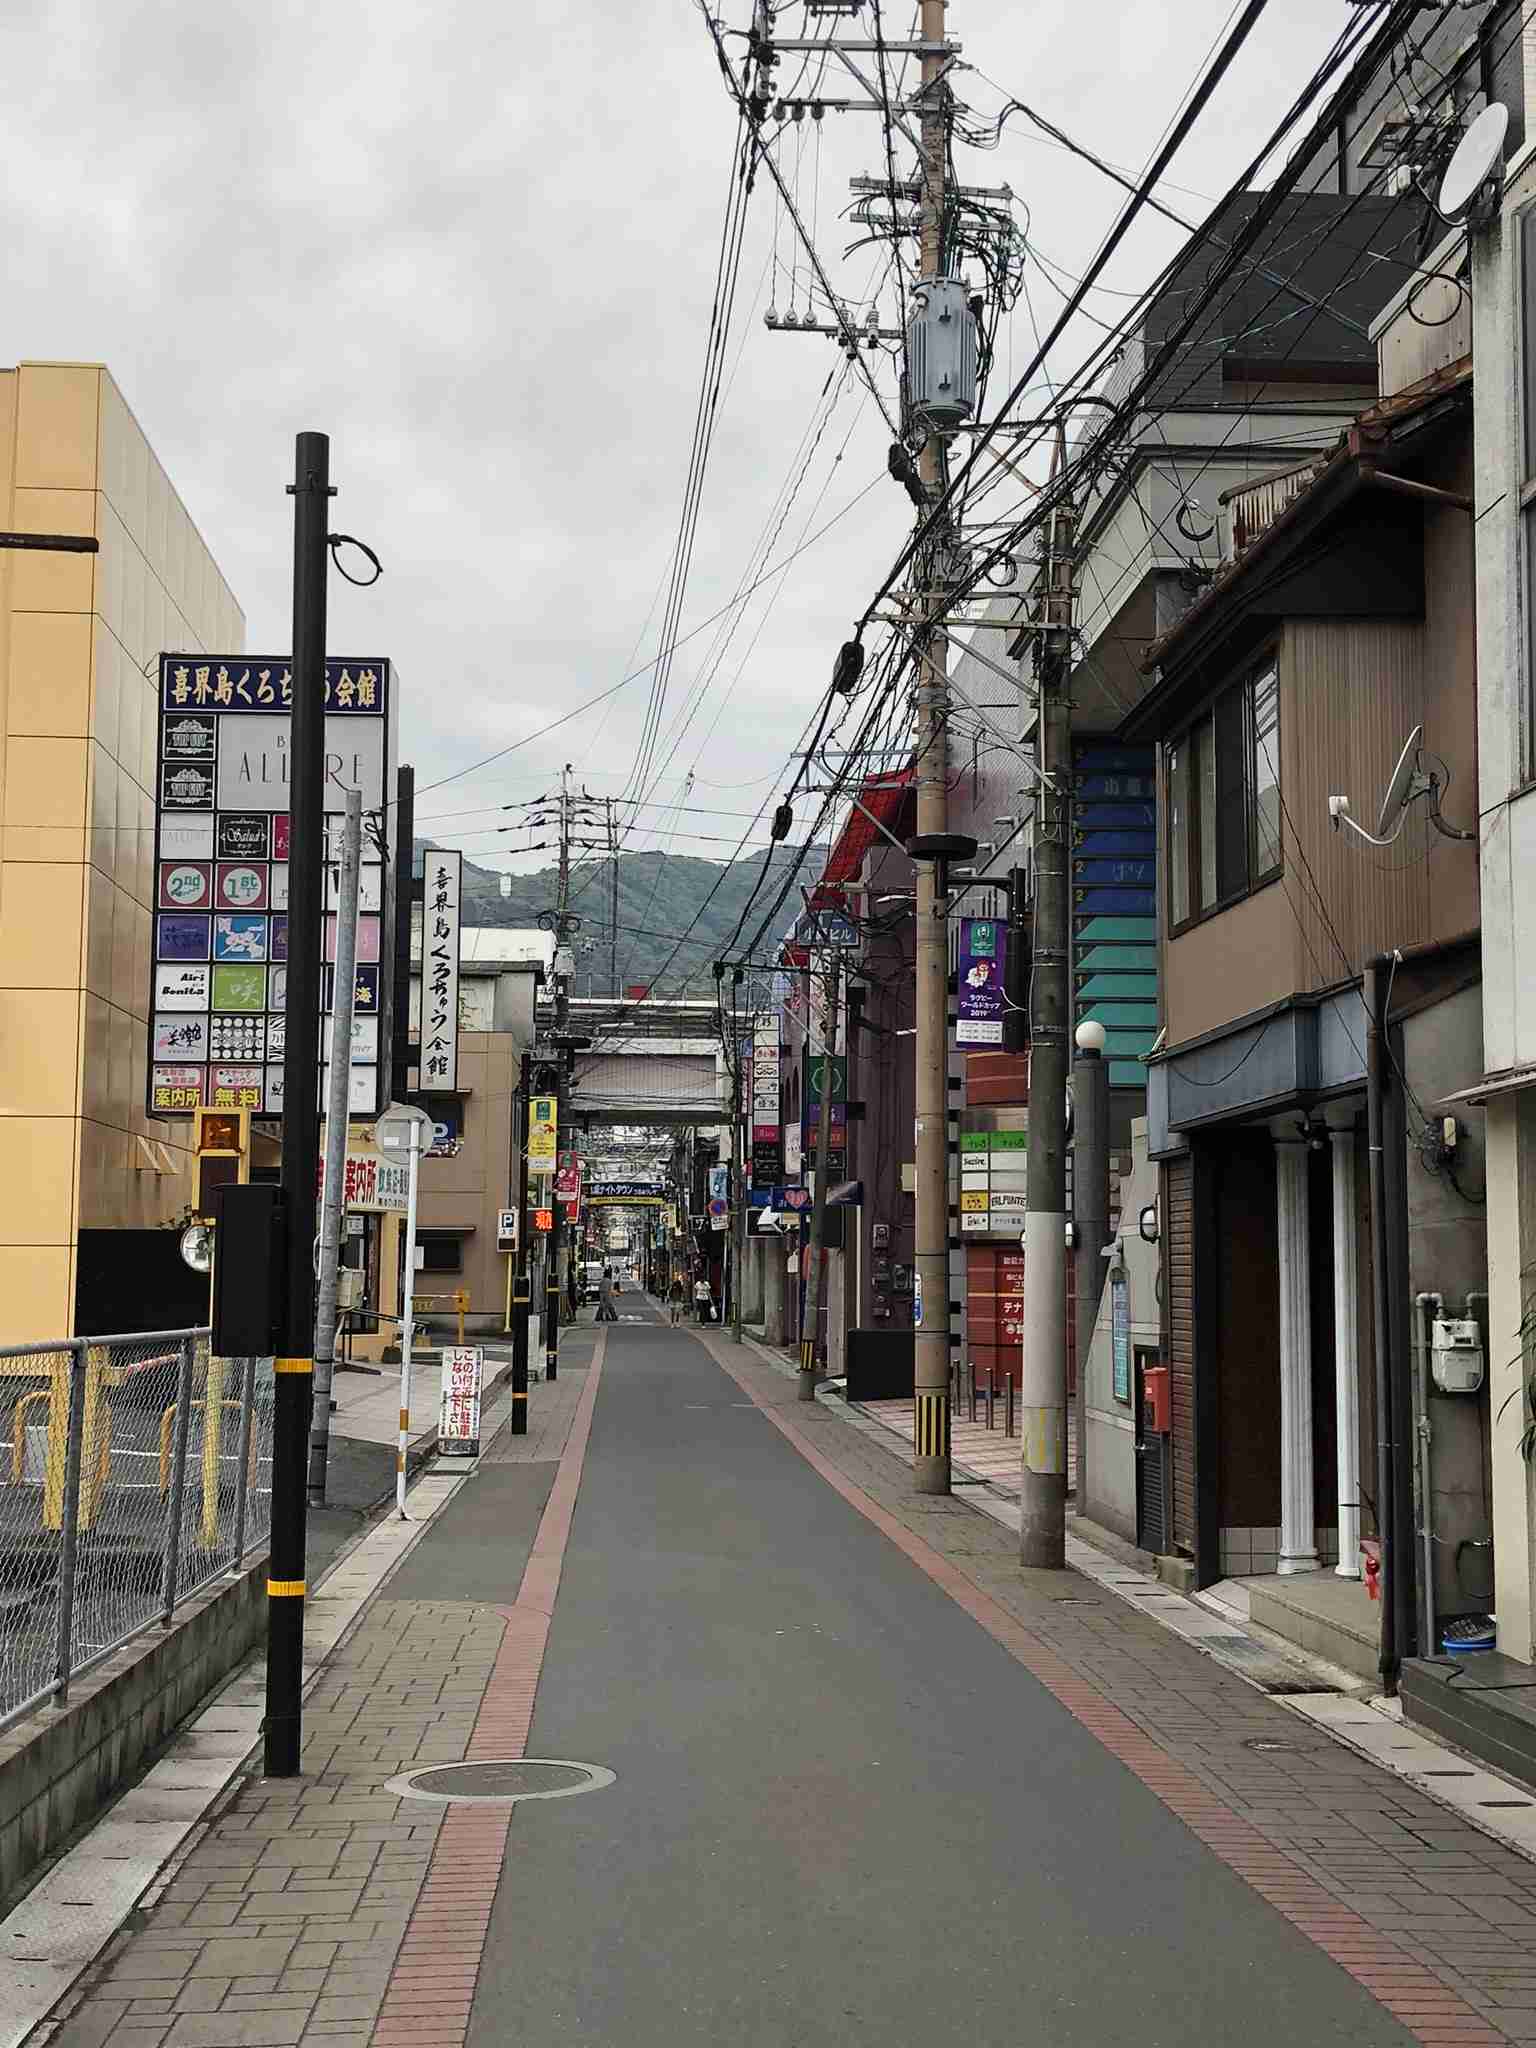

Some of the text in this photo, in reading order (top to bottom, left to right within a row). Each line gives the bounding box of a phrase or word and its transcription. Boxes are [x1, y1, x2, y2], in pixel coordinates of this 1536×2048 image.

[171, 665, 377, 707] 喜界島くろち会館
[239, 752, 366, 784] ALLRE
[171, 874, 200, 897] 2nd
[228, 875, 257, 898] 1st
[181, 973, 205, 982] Airi
[427, 867, 456, 1075] 喜界島くろちゅう会館
[162, 986, 205, 995] Bonita
[961, 1001, 1001, 1010] ワールドカップ
[155, 1088, 201, 1106] 案内所
[215, 1088, 260, 1106] 無料
[503, 1214, 513, 1226] P
[448, 1349, 462, 1436] しないで下さい
